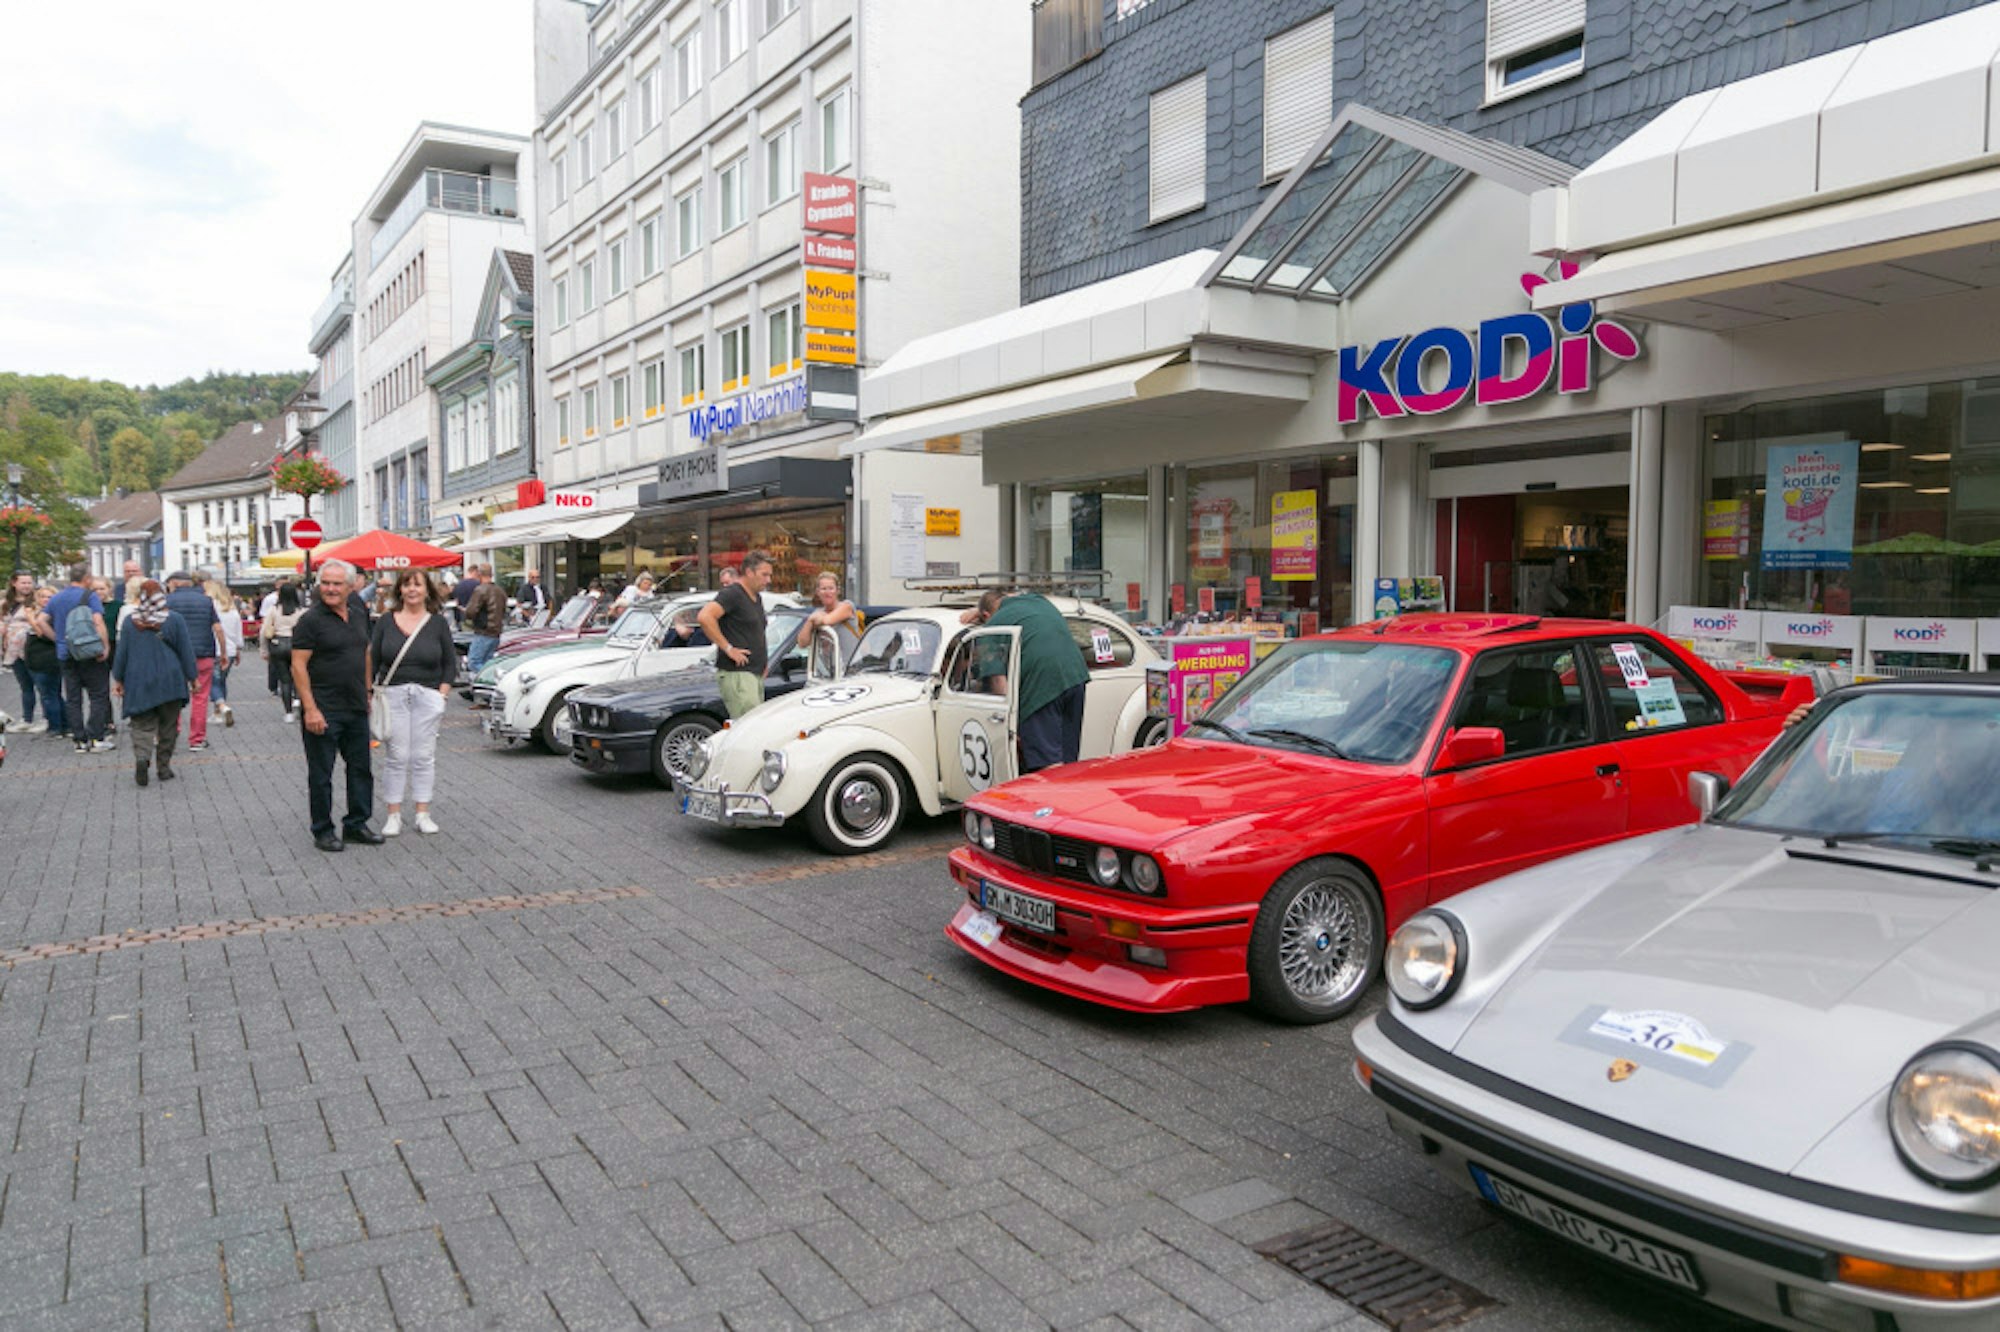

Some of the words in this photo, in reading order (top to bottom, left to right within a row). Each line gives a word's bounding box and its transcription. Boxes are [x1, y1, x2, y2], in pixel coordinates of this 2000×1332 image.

[811, 184, 851, 201] Kranken-
[807, 202, 854, 222] Gymnastik
[817, 243, 854, 260] Franken
[806, 284, 855, 300] MyPupil
[689, 397, 743, 442] MyPupil
[745, 378, 808, 423] Nachhilfe
[688, 453, 717, 478] PHONE
[1798, 455, 1825, 463] Mein
[1783, 473, 1841, 488] kodi.de
[555, 493, 593, 508] NKD
[375, 556, 411, 568] NKD
[1177, 654, 1246, 671] WERBUNG
[1619, 655, 1643, 677] 89
[963, 733, 991, 781] 53
[1014, 895, 1053, 928] 3030H
[1630, 1024, 1680, 1051] 36
[1494, 1180, 1535, 1218] GM
[1550, 1207, 1595, 1245] RC
[1599, 1227, 1695, 1284] 911H
